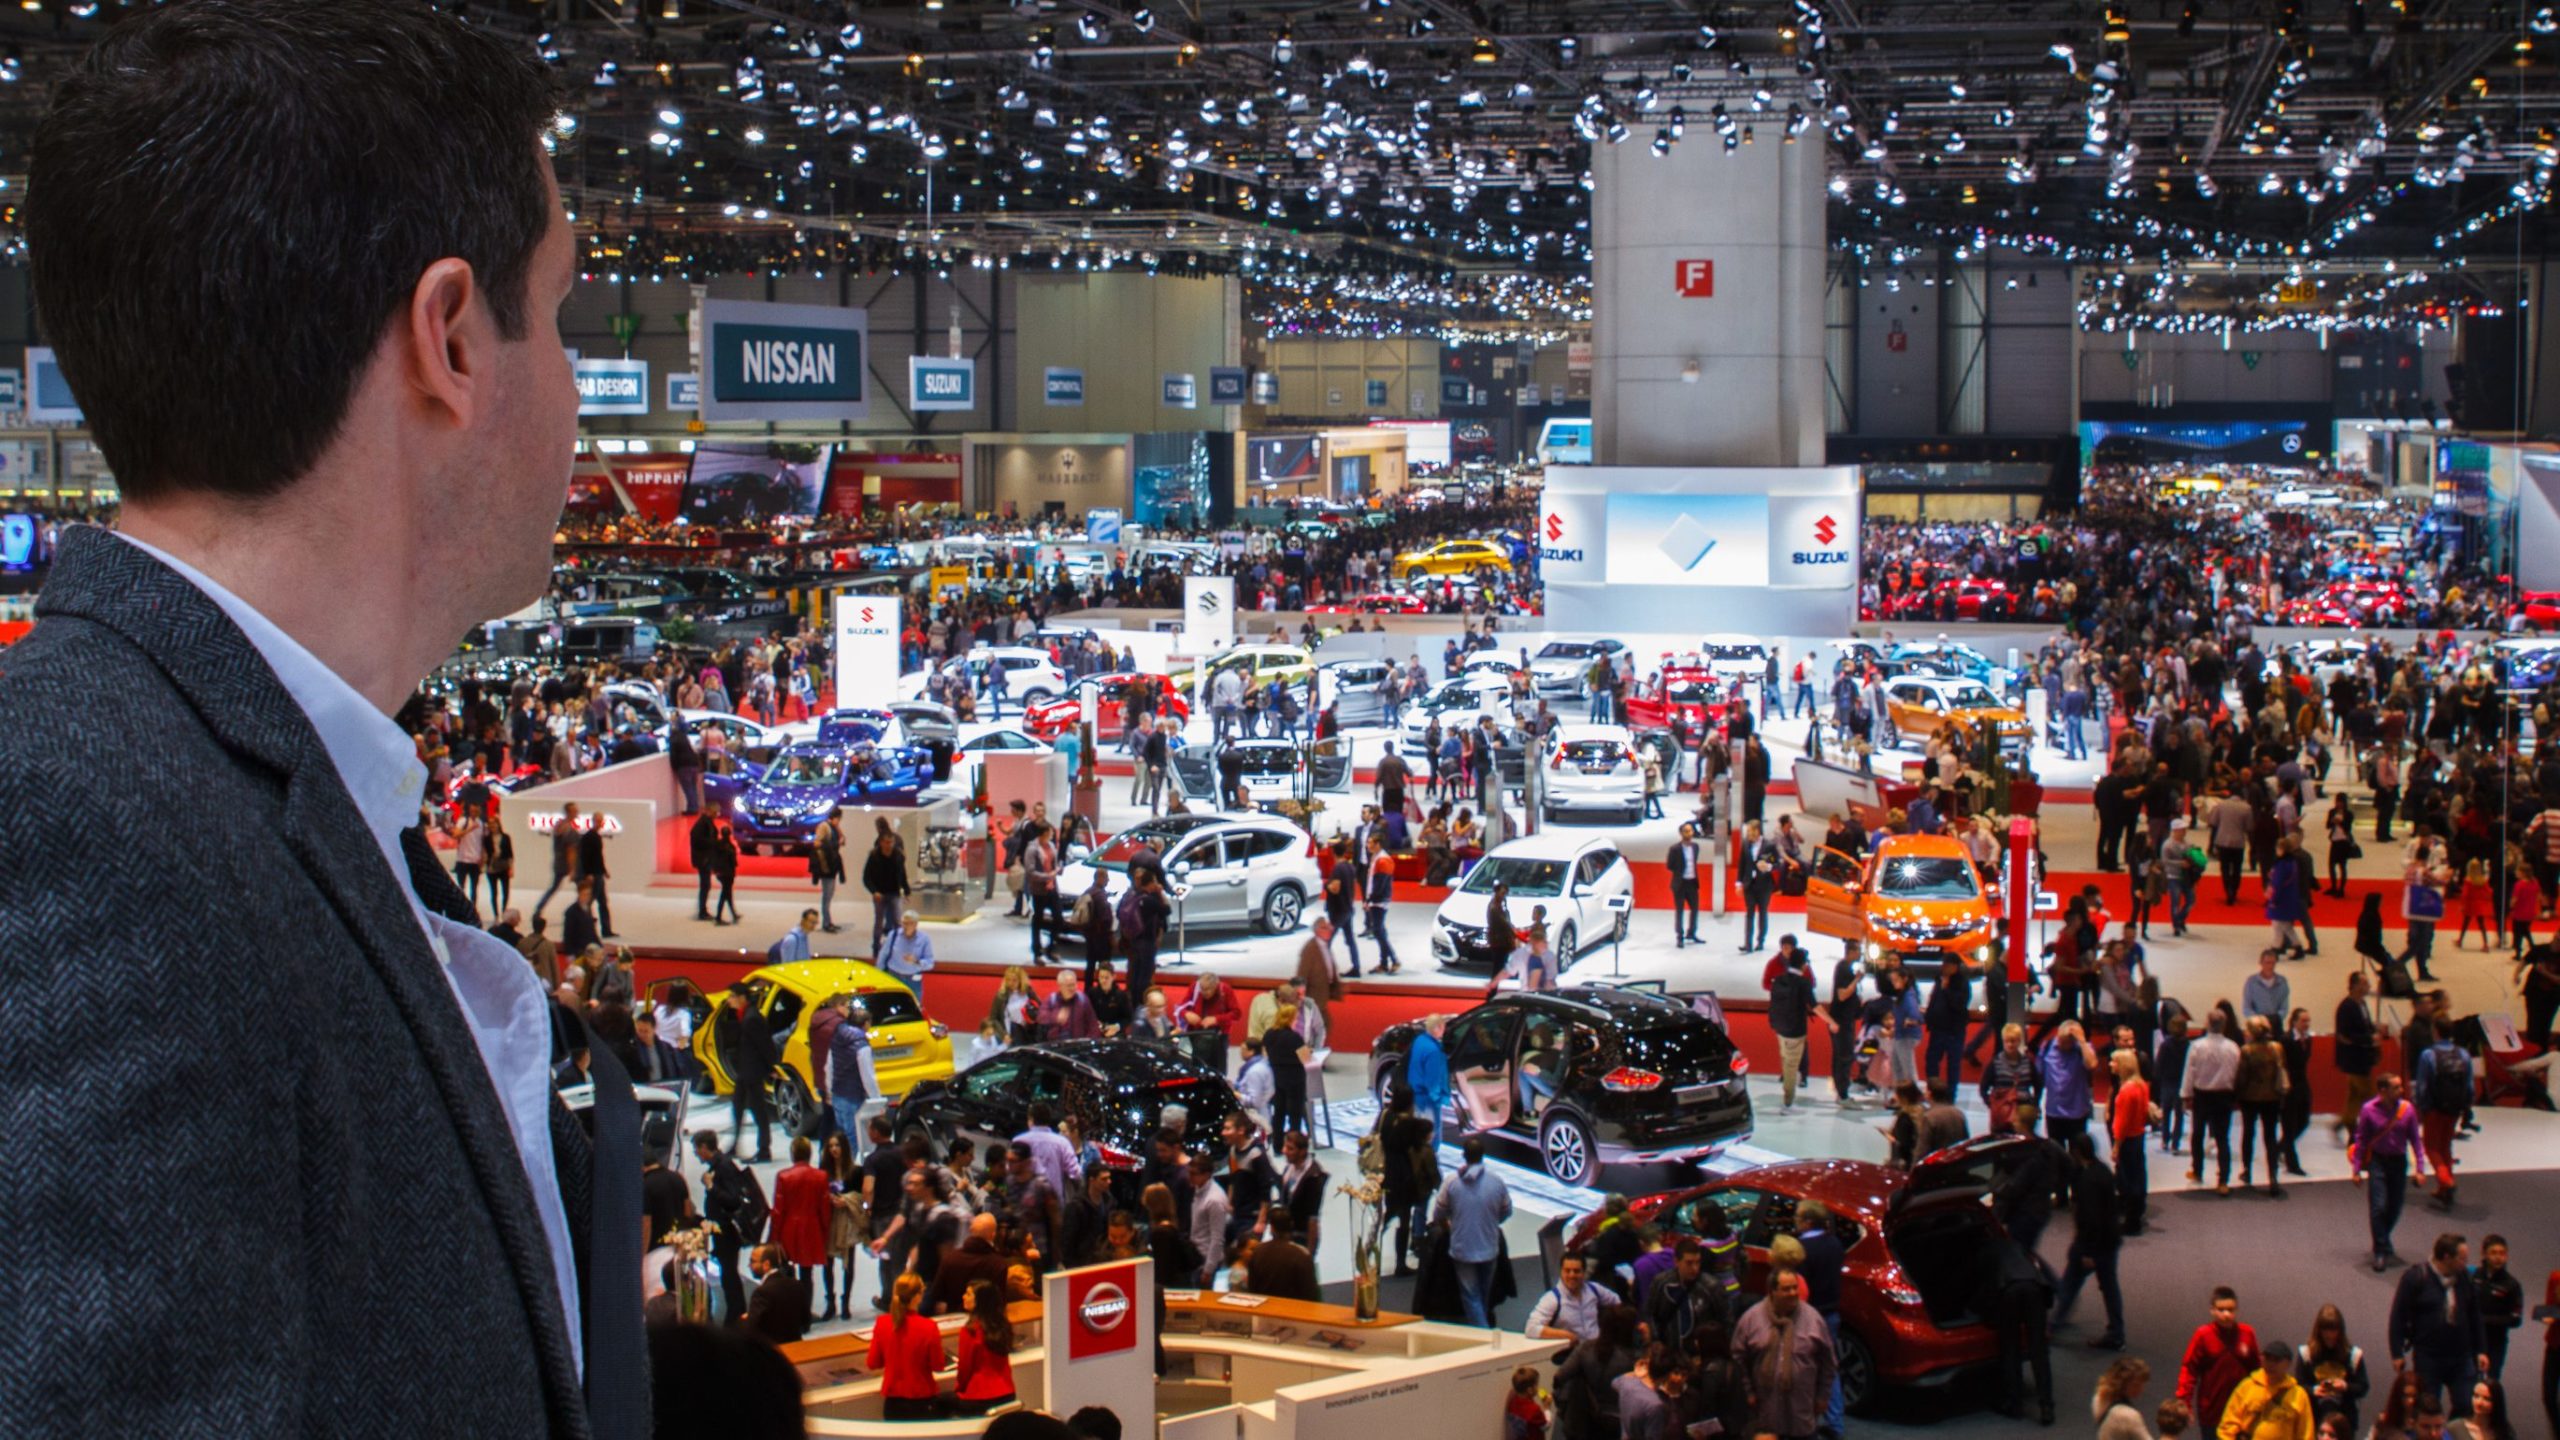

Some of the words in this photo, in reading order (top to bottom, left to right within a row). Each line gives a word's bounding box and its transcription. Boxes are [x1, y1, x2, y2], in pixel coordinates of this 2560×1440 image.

[1685, 262, 1707, 290] F
[742, 339, 836, 385] NISSAN
[597, 377, 638, 397] DESIGN
[925, 373, 962, 394] SUZUKI
[847, 627, 890, 636] SUZUKI
[1084, 1300, 1127, 1317] NISSAN
[1325, 1393, 1370, 1410] Innovation
[1371, 1388, 1389, 1401] that
[1389, 1382, 1420, 1397] excites
